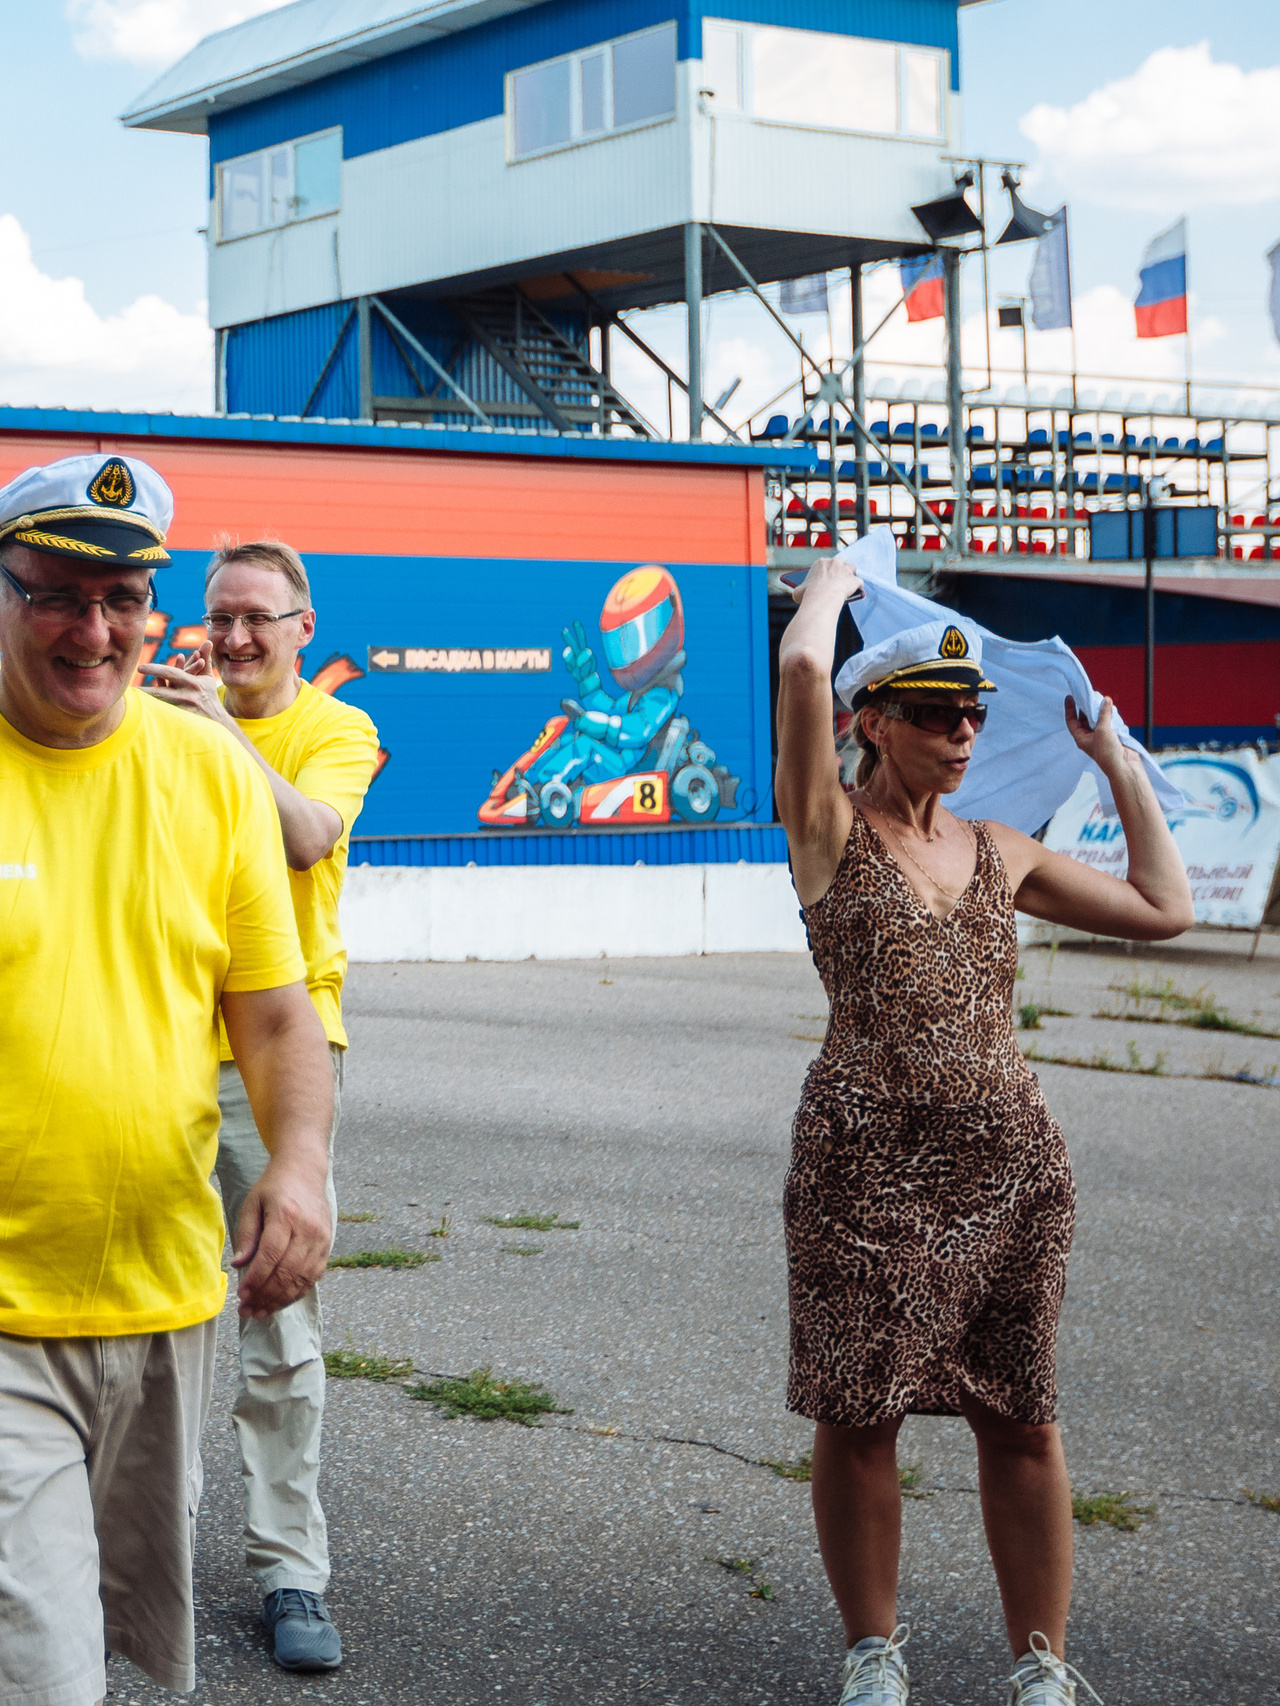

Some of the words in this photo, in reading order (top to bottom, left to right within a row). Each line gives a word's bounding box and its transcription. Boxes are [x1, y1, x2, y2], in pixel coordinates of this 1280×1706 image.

[405, 649, 482, 672] ПОСАДКА
[495, 650, 550, 670] КАРТЫ
[639, 782, 657, 810] 8
